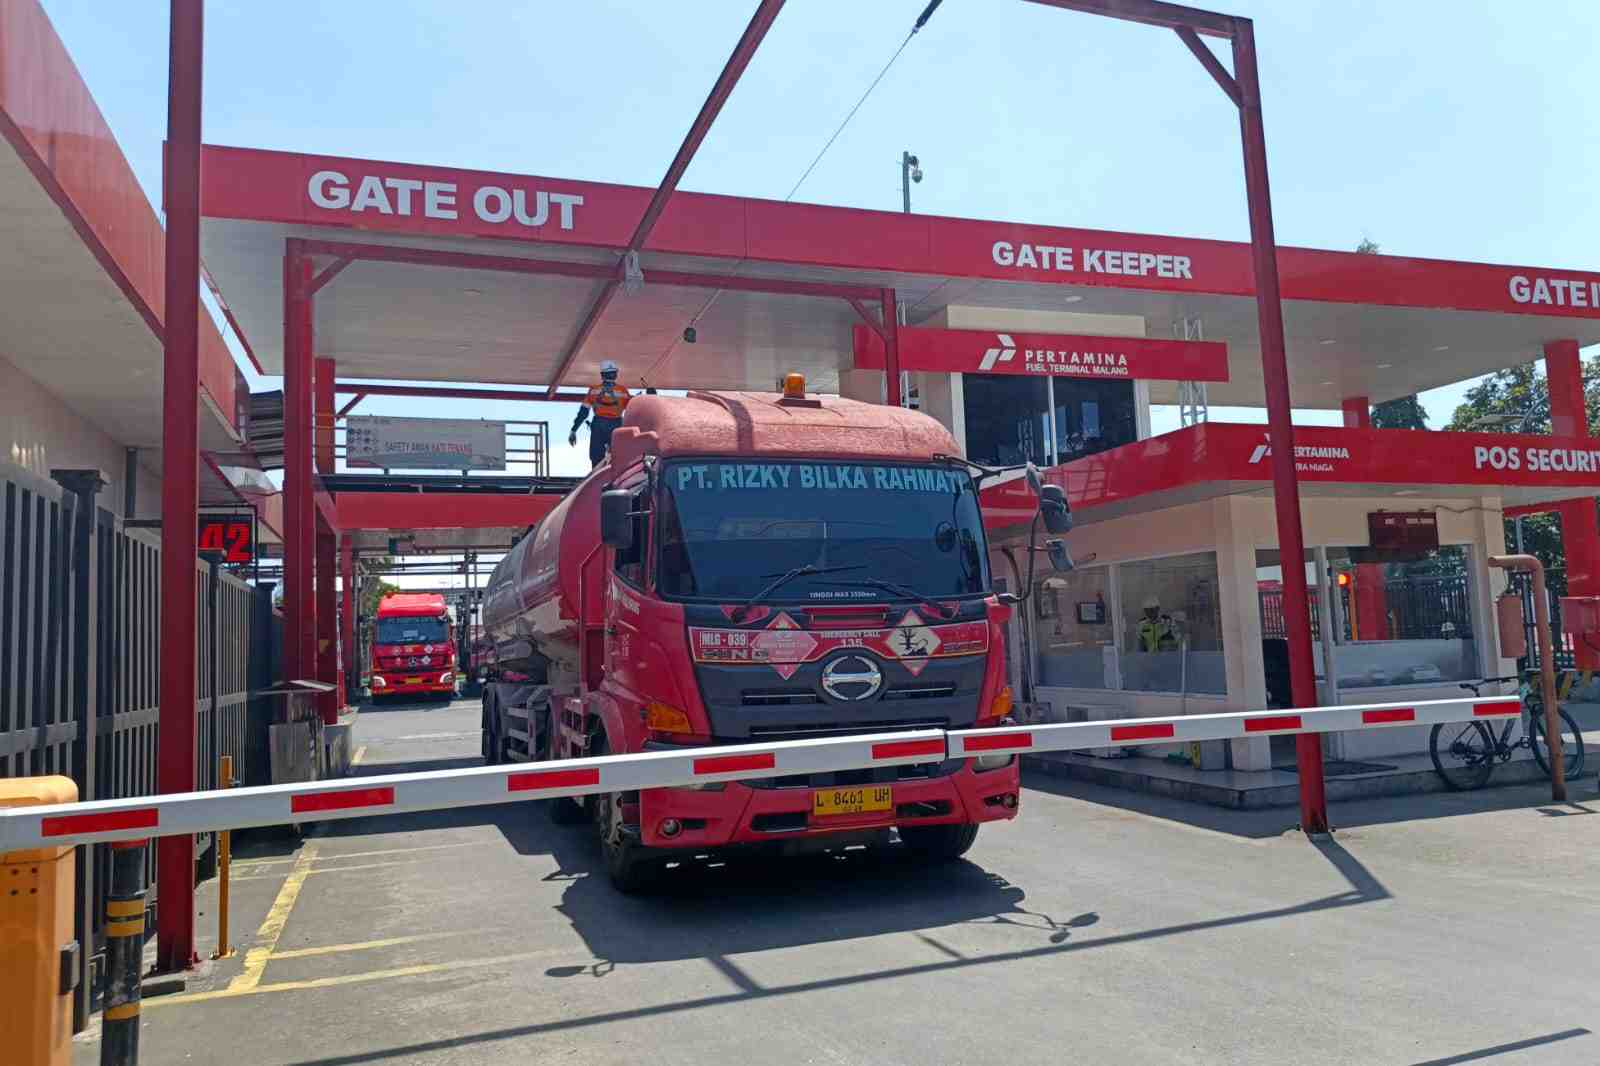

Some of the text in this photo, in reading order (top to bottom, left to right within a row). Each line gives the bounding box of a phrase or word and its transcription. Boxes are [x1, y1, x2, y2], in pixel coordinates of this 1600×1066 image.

[308, 170, 584, 229] GATE OUT
[992, 241, 1192, 279] GATE KEEPER
[1509, 275, 1587, 307] GATE
[1025, 349, 1127, 366] PERTAMINA
[1026, 363, 1129, 375] FUEL TERMINAL MALANG
[1294, 446, 1350, 459] ERTAMINA
[1474, 446, 1520, 470] POS
[678, 465, 712, 490] PT.
[719, 464, 791, 489] RIZKY
[800, 465, 868, 489] BILKA
[198, 523, 250, 561] 42
[816, 791, 824, 807] L
[874, 786, 890, 802] UH
